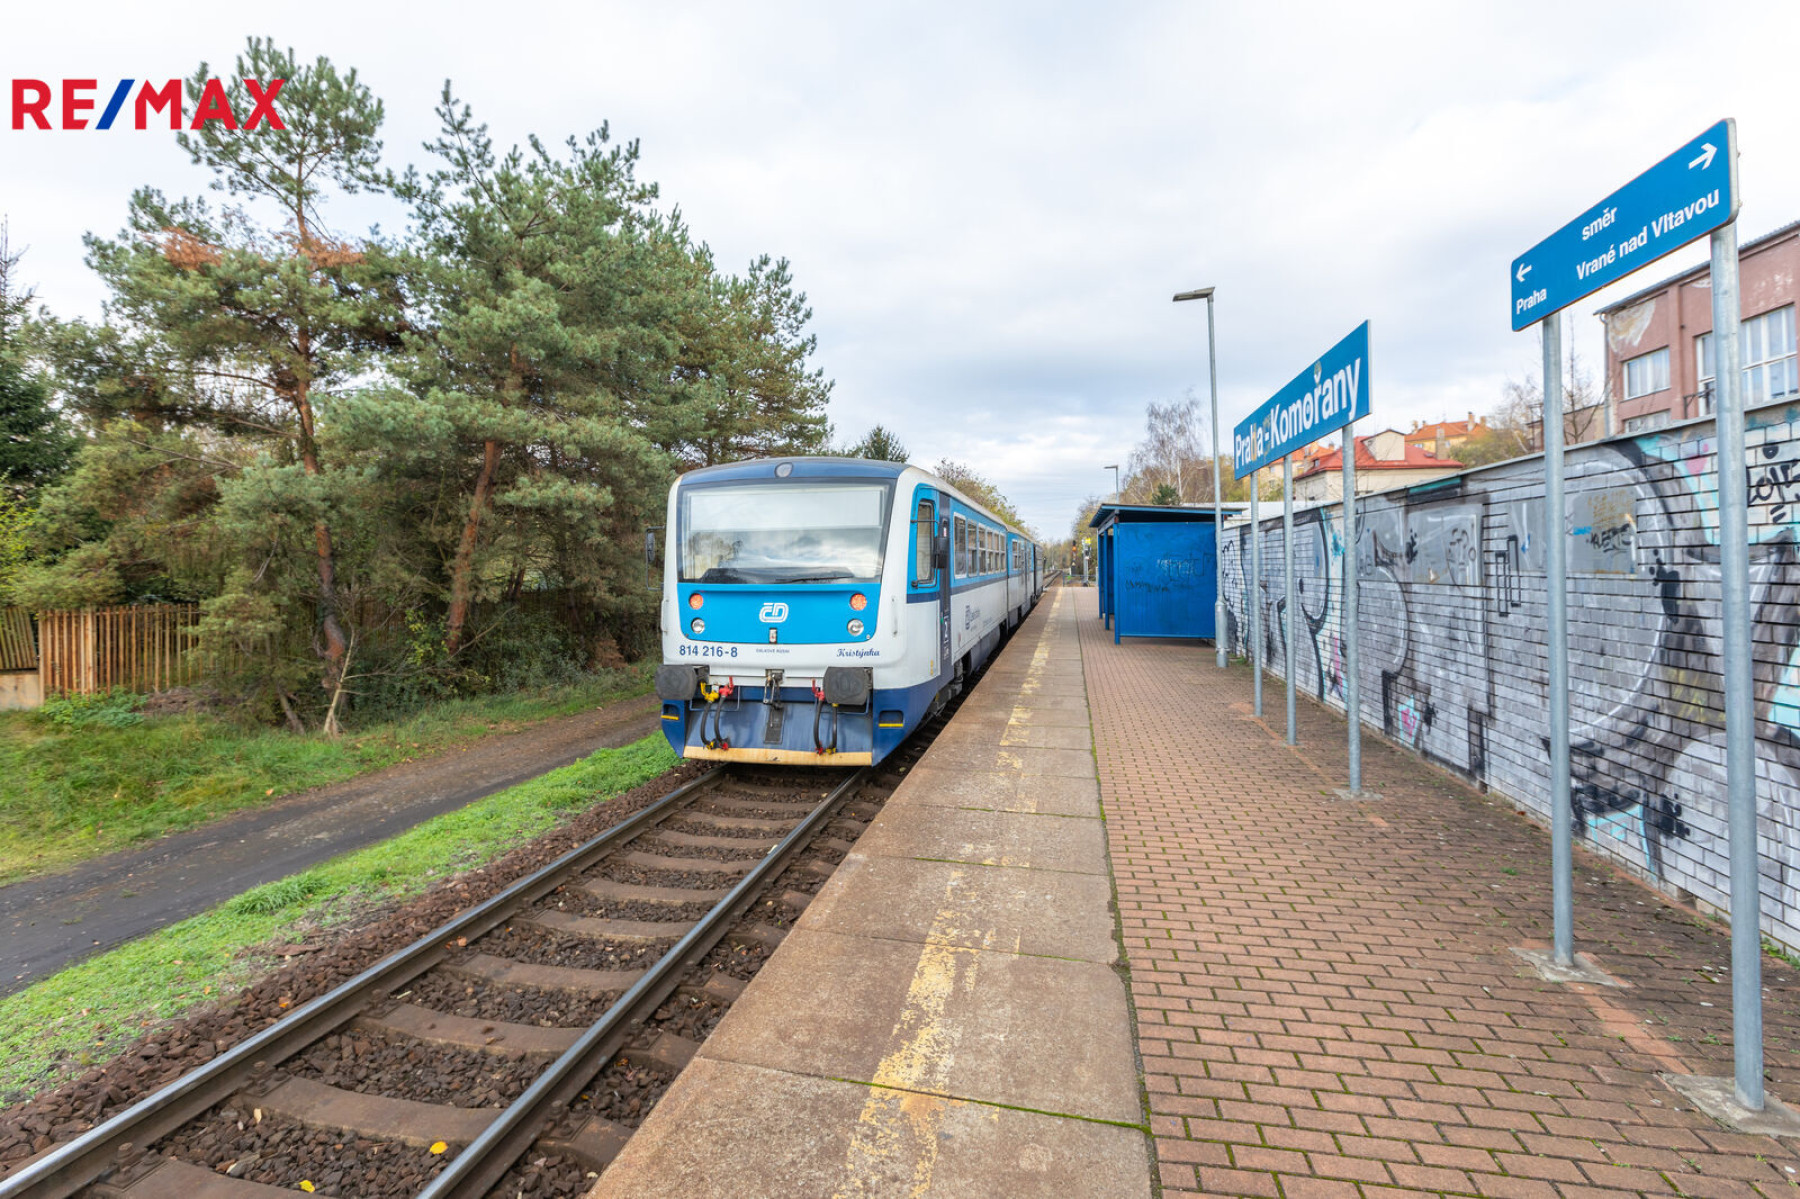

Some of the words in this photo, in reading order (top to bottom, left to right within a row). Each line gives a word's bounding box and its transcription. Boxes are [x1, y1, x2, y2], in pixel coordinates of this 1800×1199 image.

[1576, 246, 1616, 280] Vrané
[1619, 226, 1648, 258] nad
[1651, 189, 1720, 239] Vltavou
[1582, 206, 1618, 241] směr
[1516, 288, 1547, 315] Praha
[679, 645, 698, 656] 814
[702, 645, 738, 658] 216-8
[836, 648, 880, 659] Kristýnka
